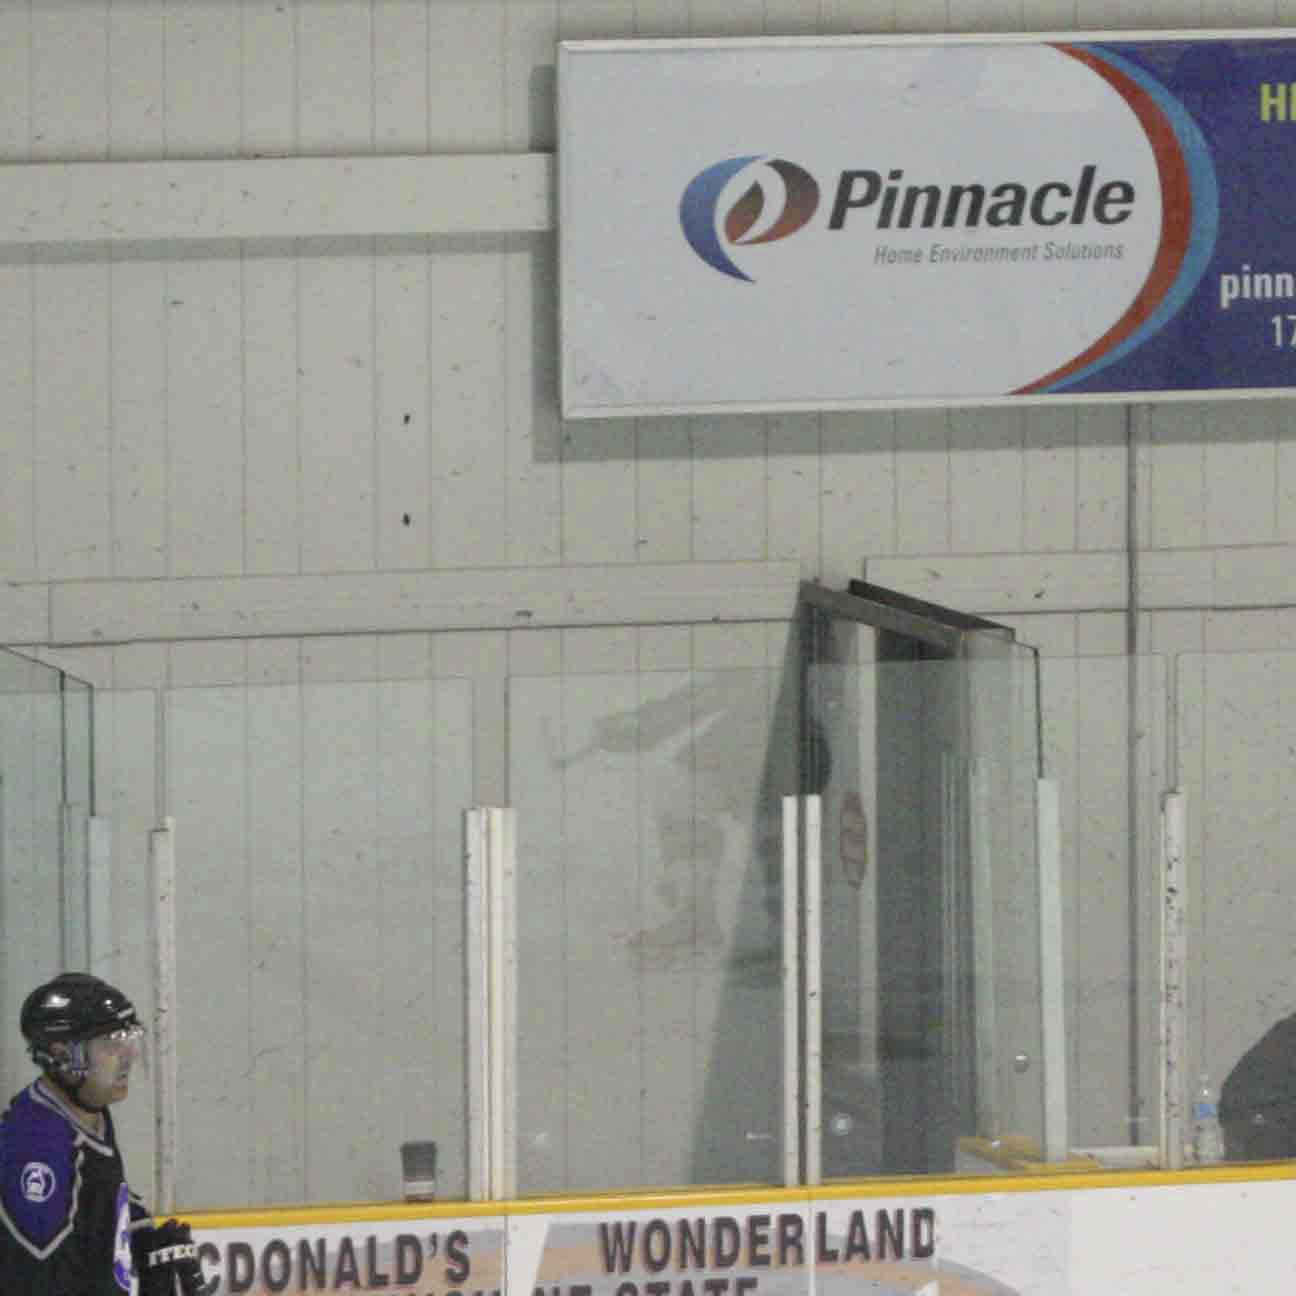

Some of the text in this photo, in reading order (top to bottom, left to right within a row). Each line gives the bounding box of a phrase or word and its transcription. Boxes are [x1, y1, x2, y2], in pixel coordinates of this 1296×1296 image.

[827, 164, 1136, 231] Pinnacle
[873, 240, 1124, 267] Home Environment Solutions
[196, 1206, 936, 1295] CDONALD'S WONDERLAND
